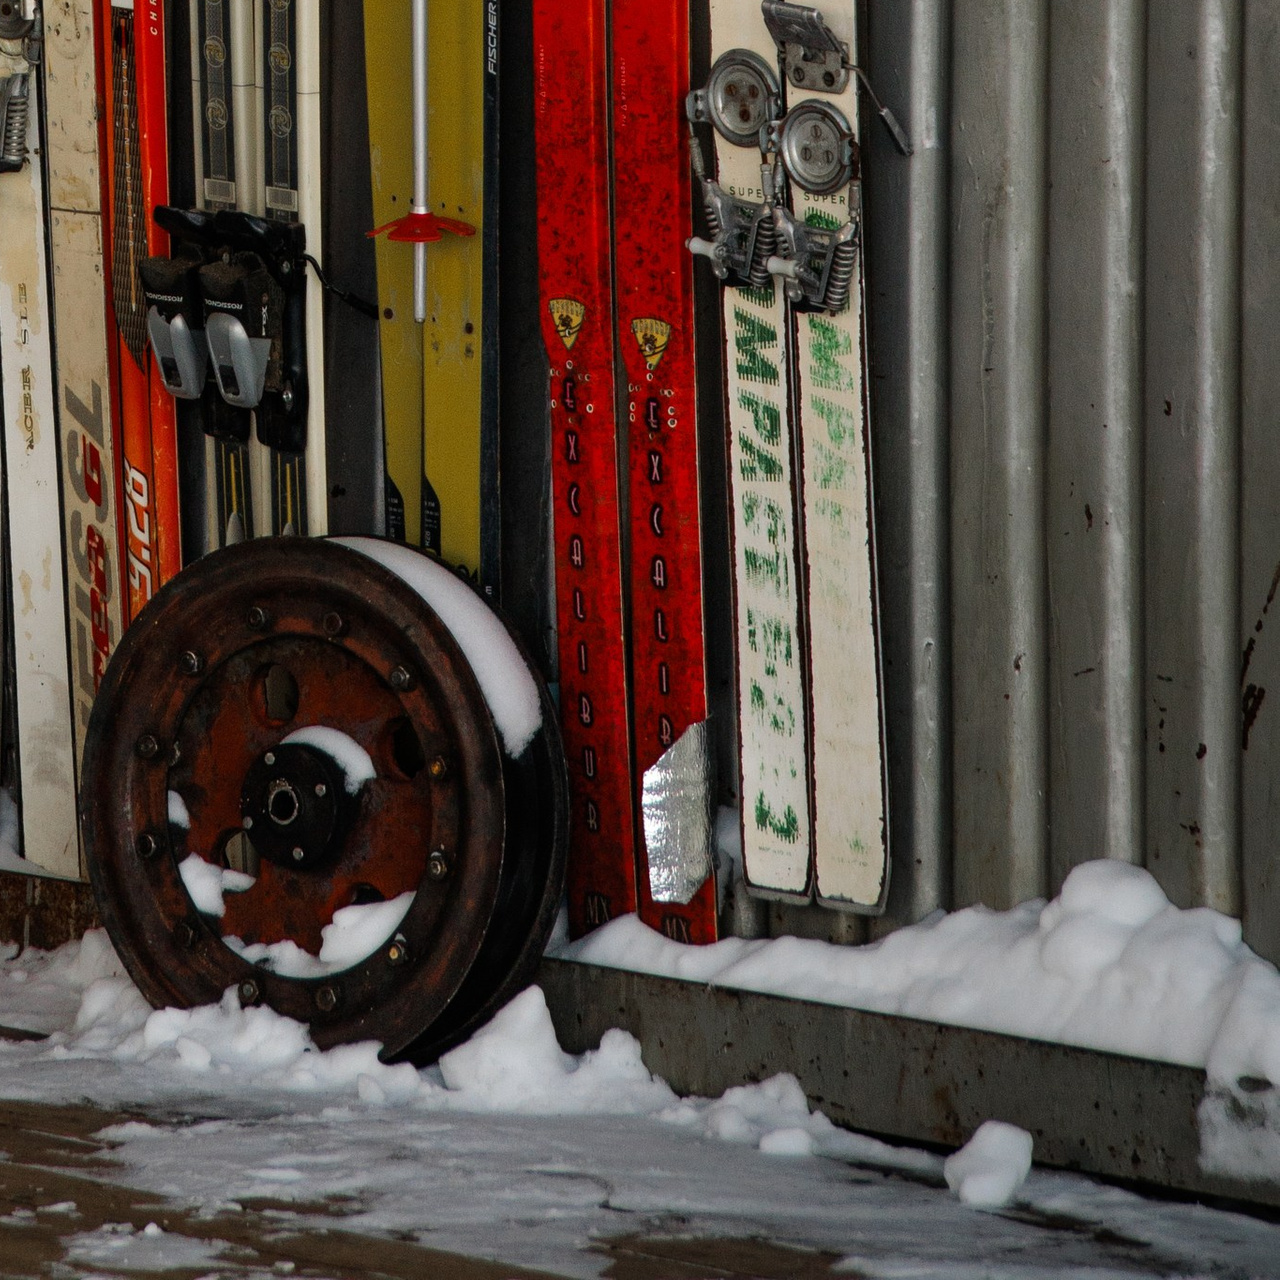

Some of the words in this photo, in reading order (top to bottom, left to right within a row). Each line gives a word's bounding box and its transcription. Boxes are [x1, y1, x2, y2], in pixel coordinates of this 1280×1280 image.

[488, 2, 498, 75] FISCHER
[123, 126, 130, 147] IN
[729, 186, 762, 199] SUPE
[803, 192, 846, 206] SUPER
[124, 161, 134, 249] AUSTRIA
[145, 292, 183, 302] ROSSIGNOL
[205, 298, 243, 310] ROSSIGNOL
[647, 400, 671, 744] EXCALIB
[565, 382, 598, 830] EXCALIBUR
